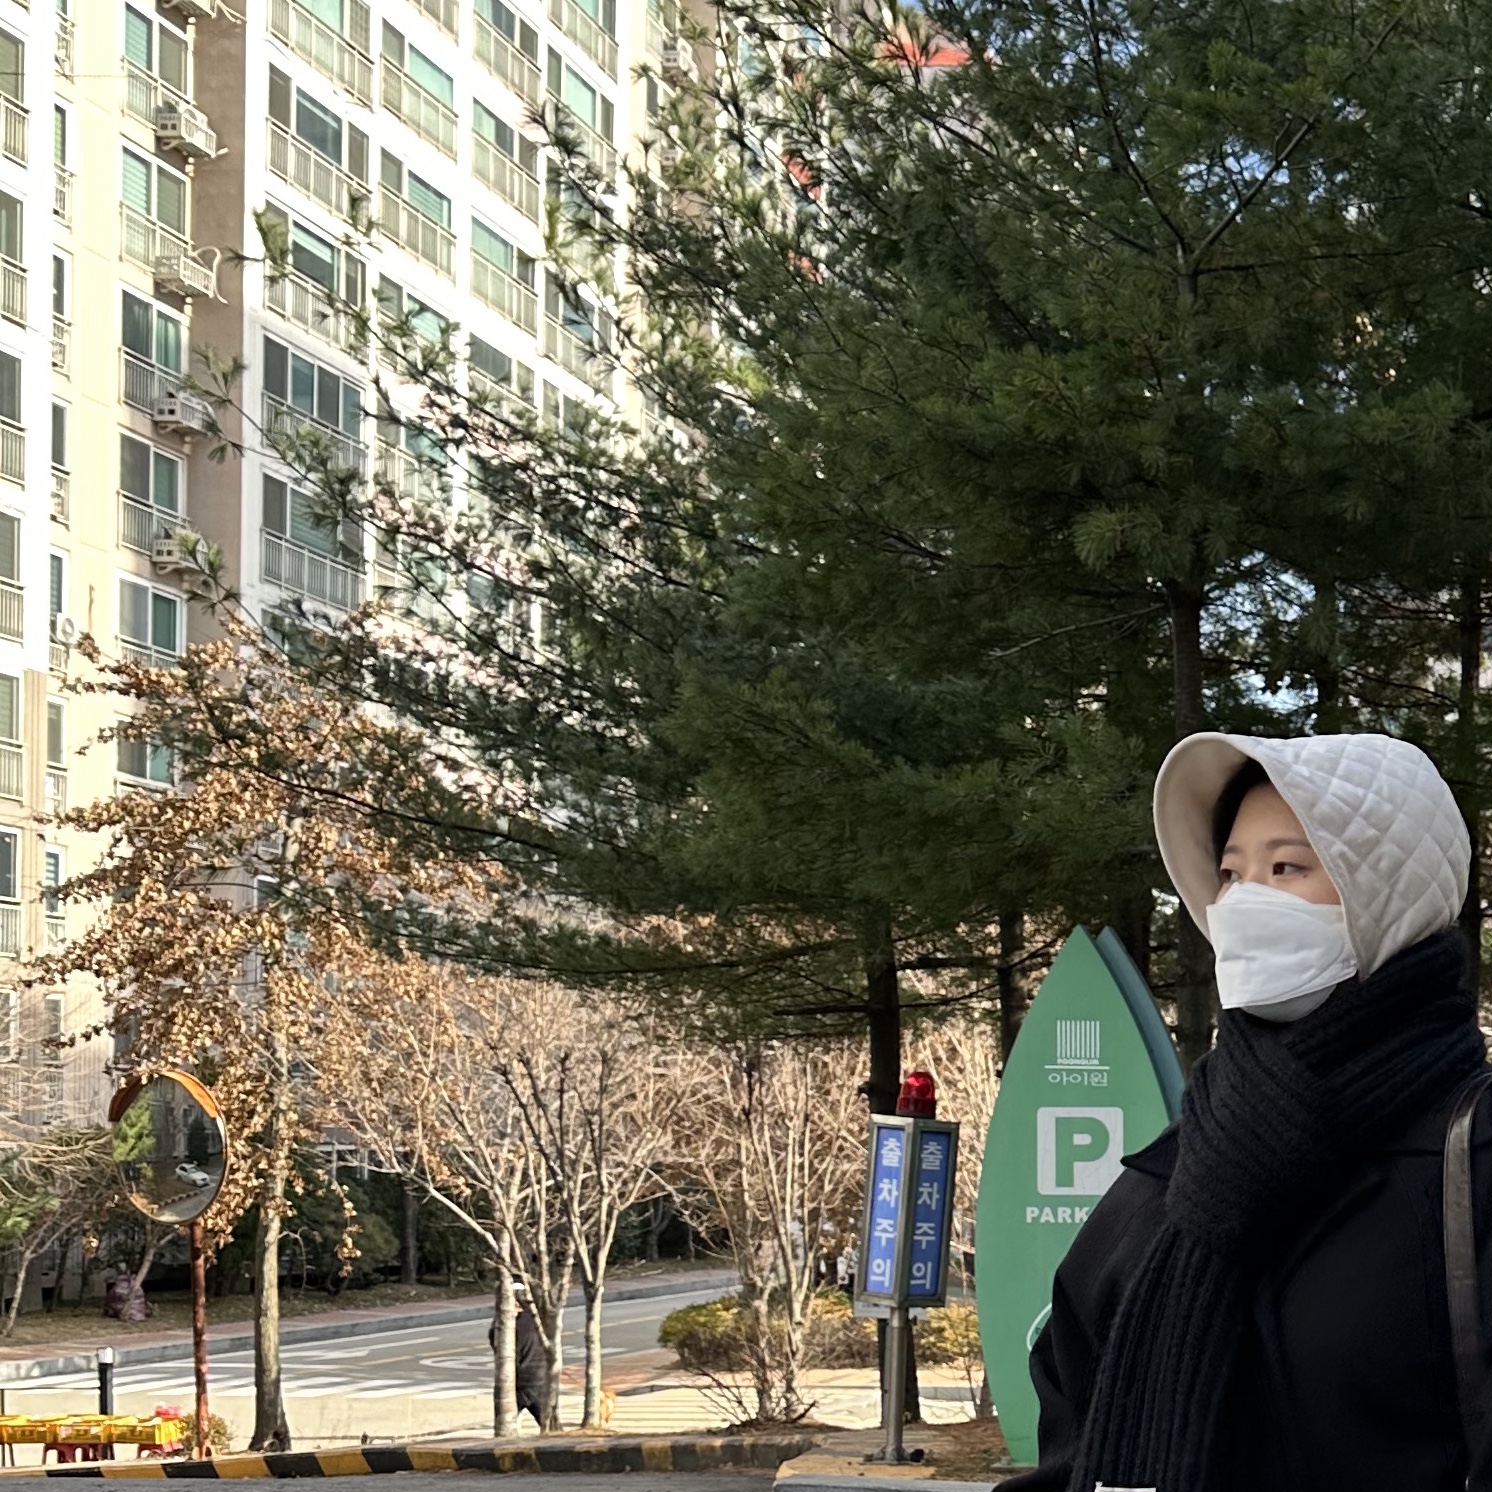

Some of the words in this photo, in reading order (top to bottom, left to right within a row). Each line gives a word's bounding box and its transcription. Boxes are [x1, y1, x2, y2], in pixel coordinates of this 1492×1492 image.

[1048, 1071, 1108, 1087] 아이원
[1055, 1116, 1111, 1188] P
[870, 1137, 902, 1288] 출차주의
[910, 1141, 943, 1290] 출차주의
[1025, 1206, 1090, 1224] PARK
